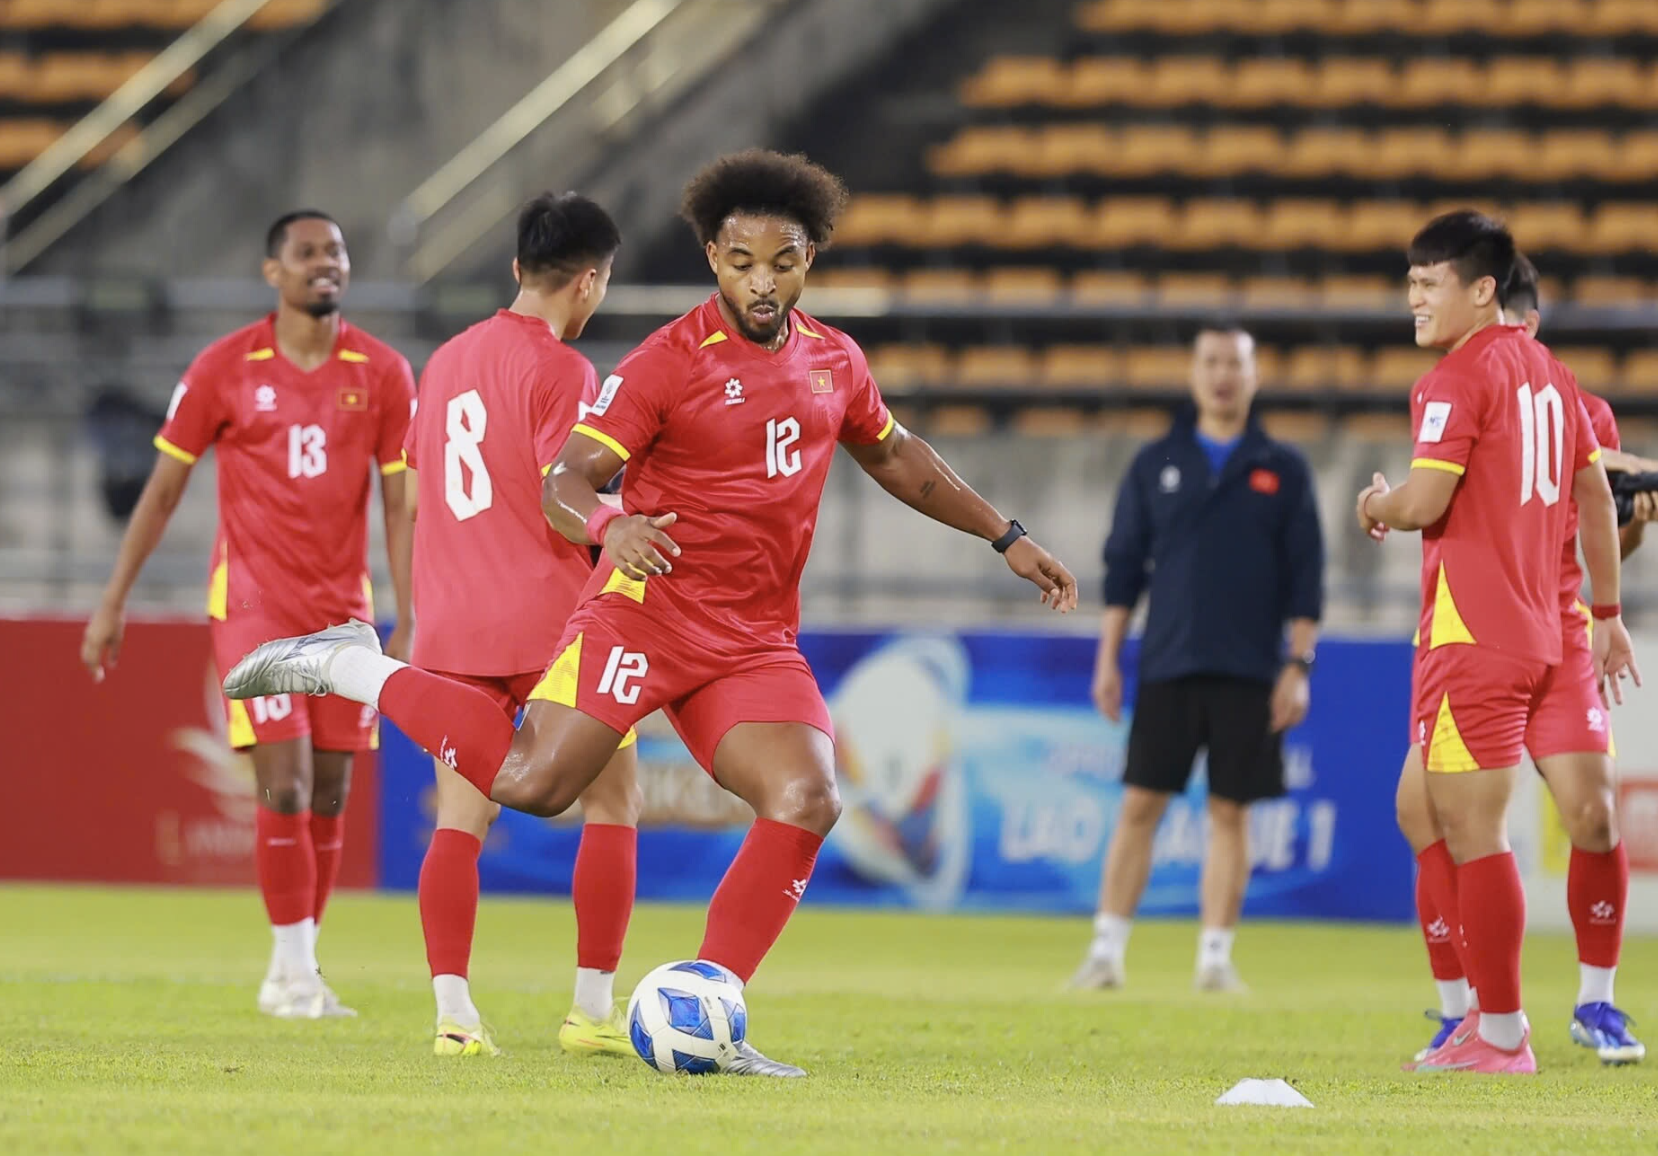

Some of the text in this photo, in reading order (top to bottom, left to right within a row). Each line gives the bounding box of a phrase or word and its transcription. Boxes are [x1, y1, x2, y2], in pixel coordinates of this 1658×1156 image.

[287, 422, 328, 479] 13
[444, 388, 493, 521] 8
[765, 416, 803, 479] 12
[1516, 381, 1565, 507] 10
[596, 645, 650, 705] 12
